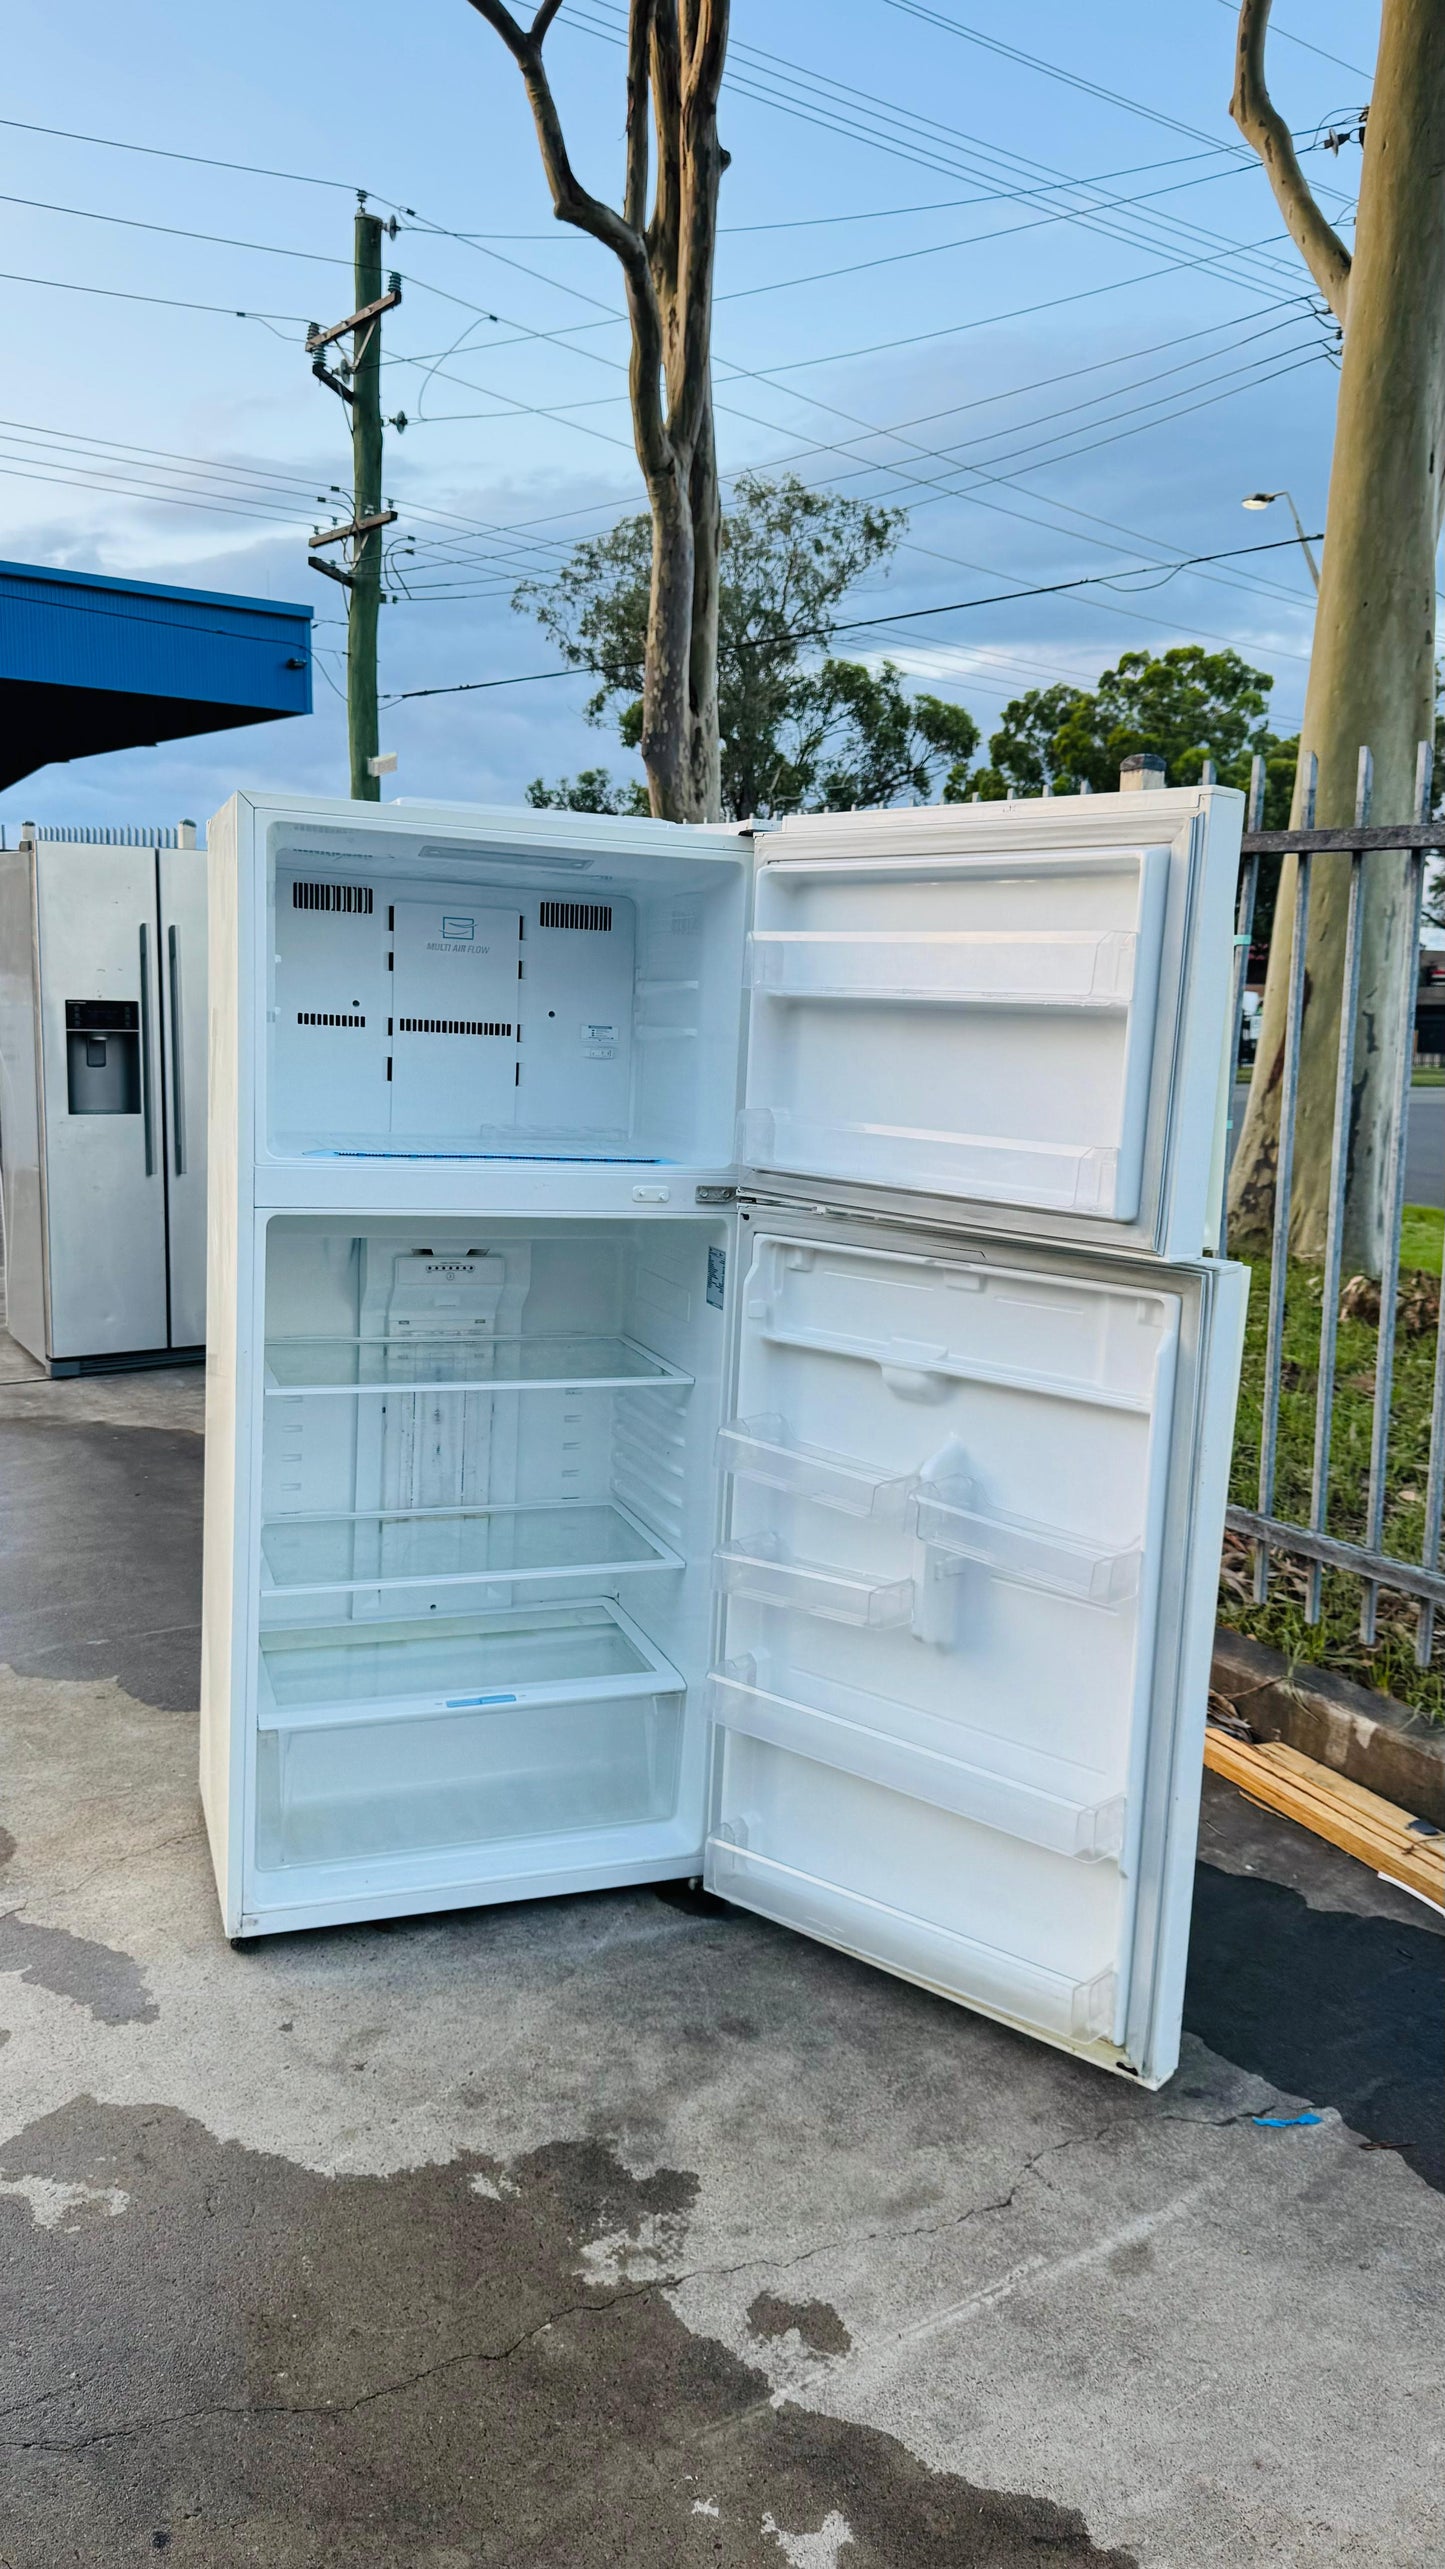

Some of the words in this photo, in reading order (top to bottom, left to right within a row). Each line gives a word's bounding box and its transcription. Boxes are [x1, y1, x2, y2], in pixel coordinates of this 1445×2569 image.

[426, 942, 451, 952] MULTI
[452, 944, 466, 953] AIR
[467, 945, 490, 954] FLOW
